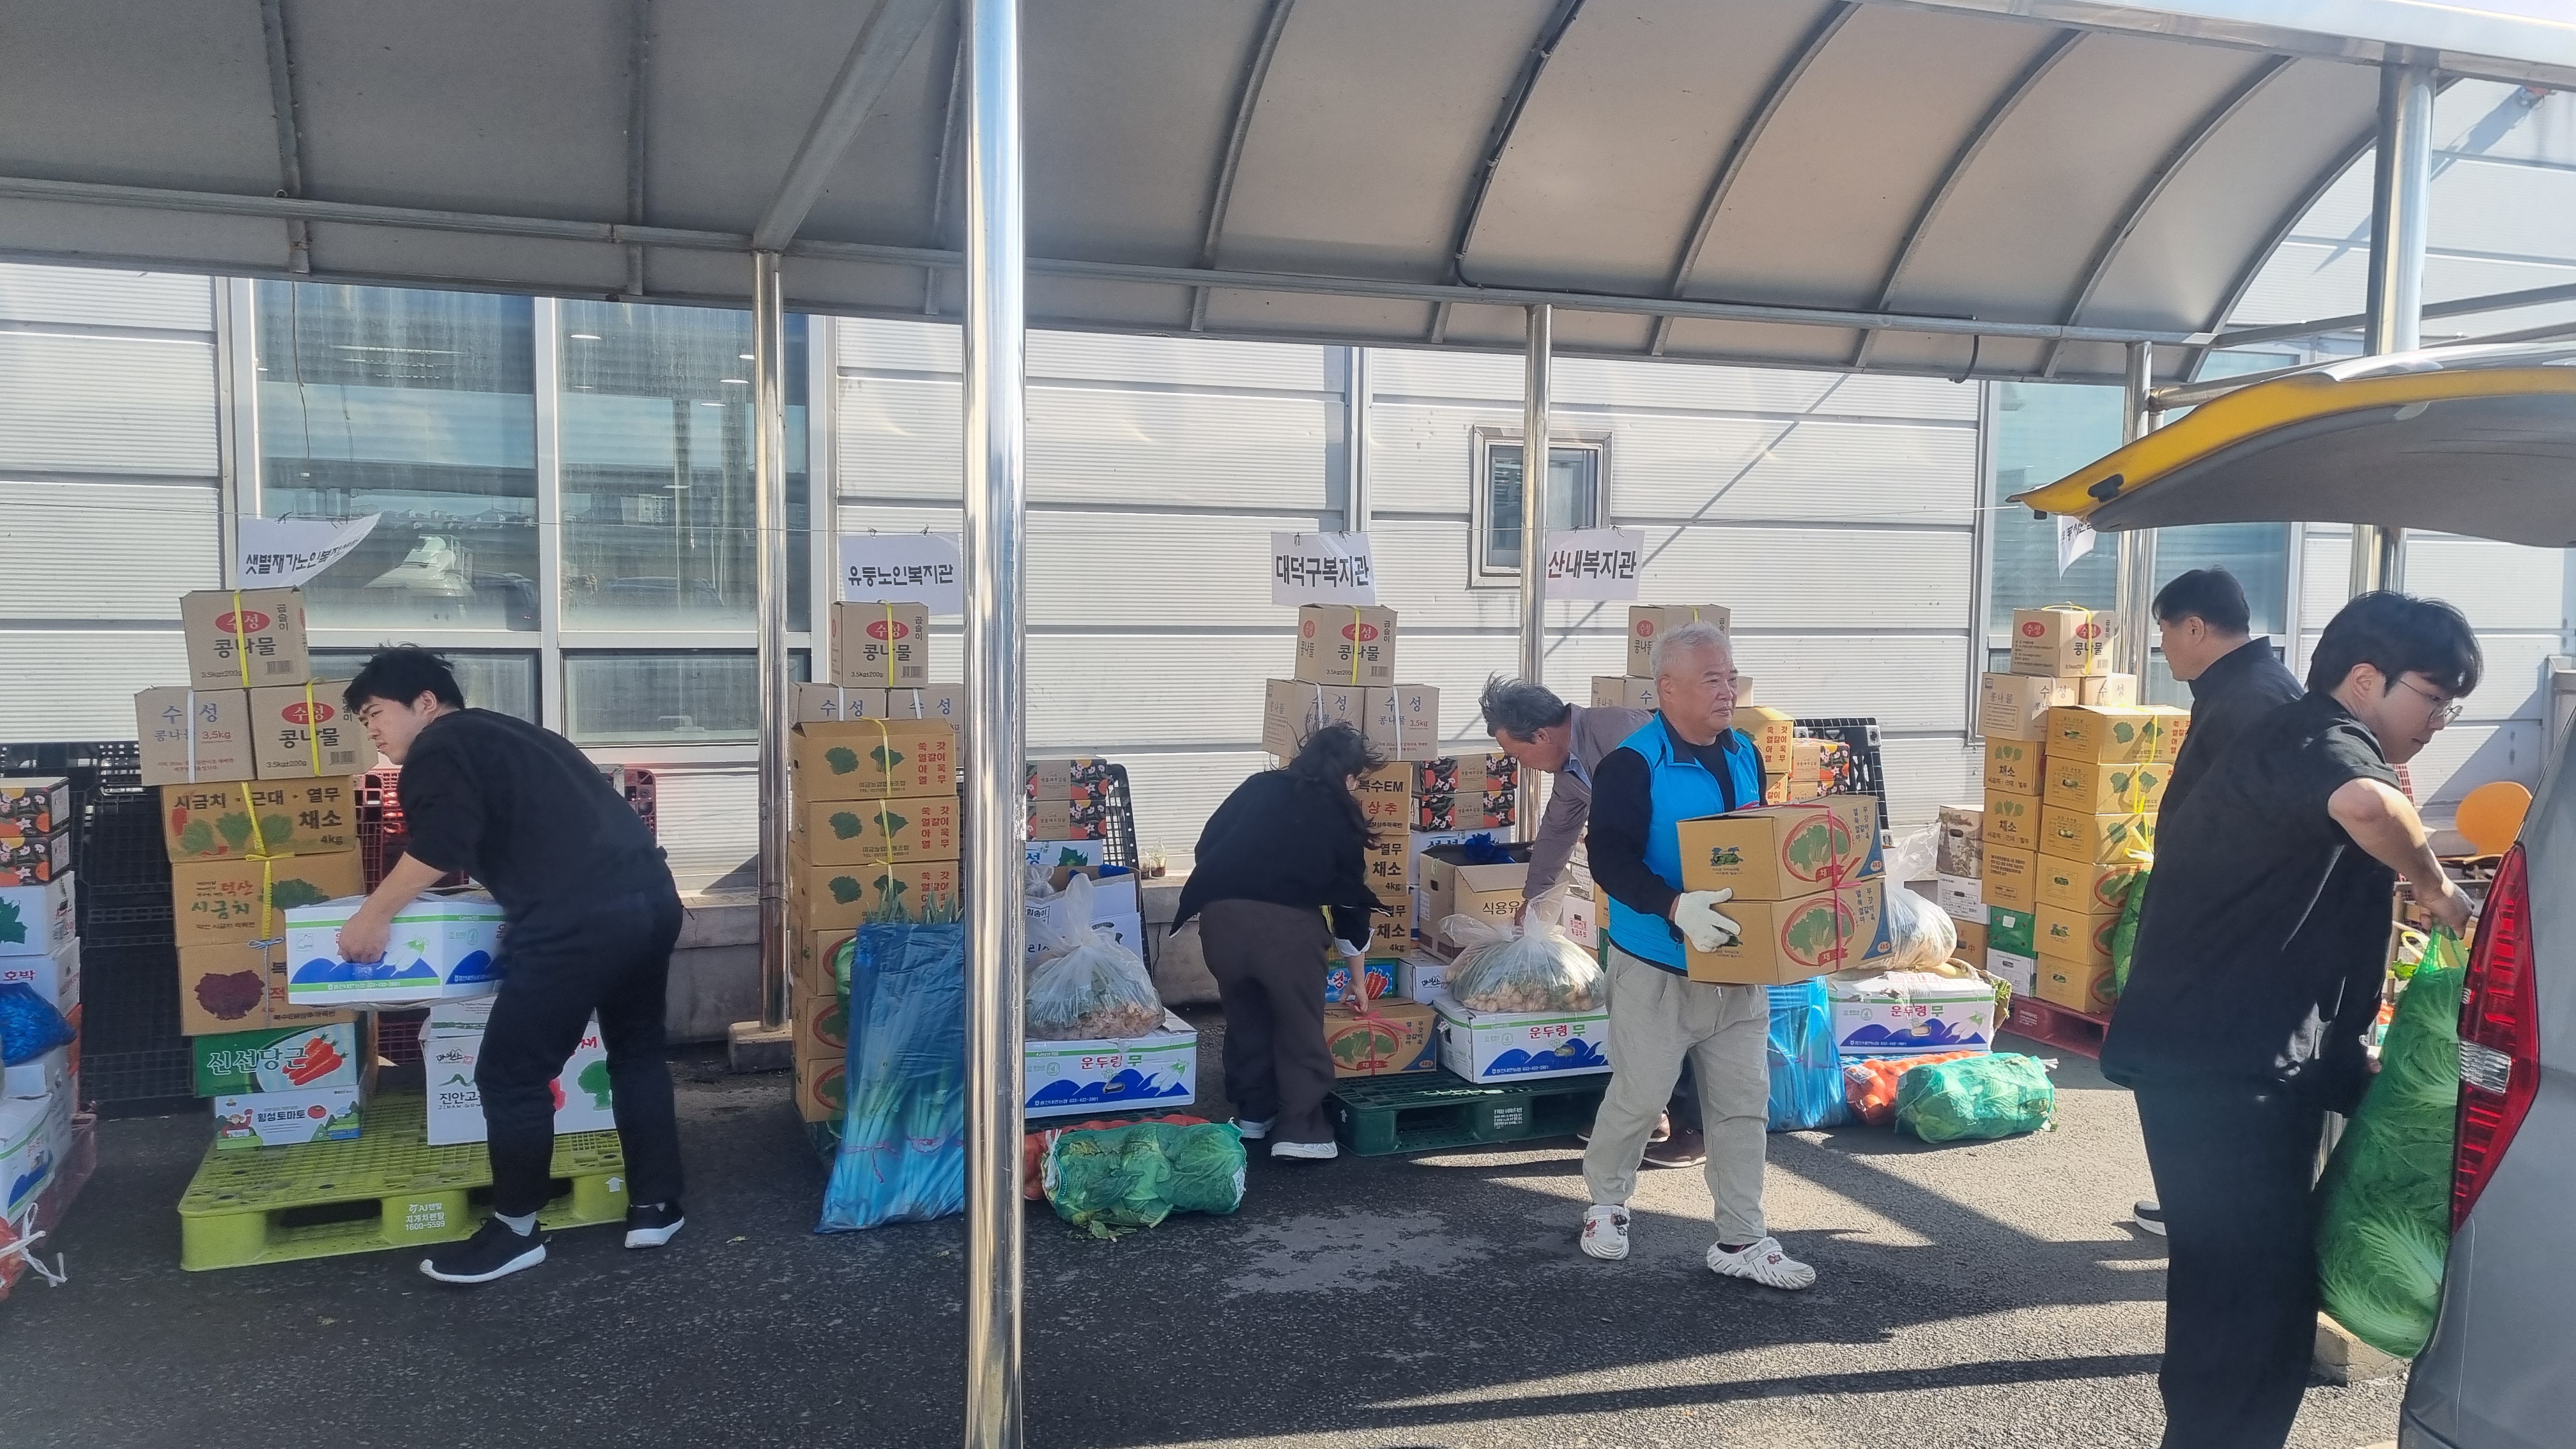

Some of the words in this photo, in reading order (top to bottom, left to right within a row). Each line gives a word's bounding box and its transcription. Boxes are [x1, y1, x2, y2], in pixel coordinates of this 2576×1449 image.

[1276, 555, 1369, 587] 대덕구복지관
[1548, 550, 1637, 579] 산내복지관
[848, 565, 953, 586] 유등노인복지관
[875, 624, 900, 638] 수성
[2027, 625, 2041, 636] 수성
[213, 637, 277, 659] 콩나물
[862, 645, 912, 661] 콩나물
[1338, 645, 1379, 661] 콩나물
[2074, 642, 2103, 656] 콩나물
[293, 705, 324, 721] 수성
[203, 730, 231, 740] 3.5kg
[279, 728, 339, 749] 콩나물
[1999, 765, 2015, 777] 채소
[174, 792, 226, 810] 시금치
[252, 790, 283, 806] 근대
[307, 787, 341, 802] 열무
[299, 809, 342, 829] 채소
[1999, 820, 2016, 832] 채소
[321, 835, 343, 845] 4kg
[1380, 843, 1402, 856] 열무
[1373, 861, 1402, 877] 채소
[1385, 882, 1400, 891] 4kg
[1483, 901, 1525, 916] 식용유
[1376, 923, 1406, 939] 채소
[1389, 944, 1404, 953] 4kg
[3, 970, 36, 981] 호박
[1891, 1006, 1927, 1017] 운두령
[1931, 1005, 1943, 1017] 무
[1529, 1025, 1568, 1039] 운두령
[1573, 1024, 1586, 1036] 무
[207, 1046, 308, 1075] 신선당근
[1081, 1055, 1123, 1070] 운두령
[1128, 1055, 1142, 1067] 무
[440, 1092, 480, 1105] 진안고
[406, 1220, 445, 1230] 1600-5599
